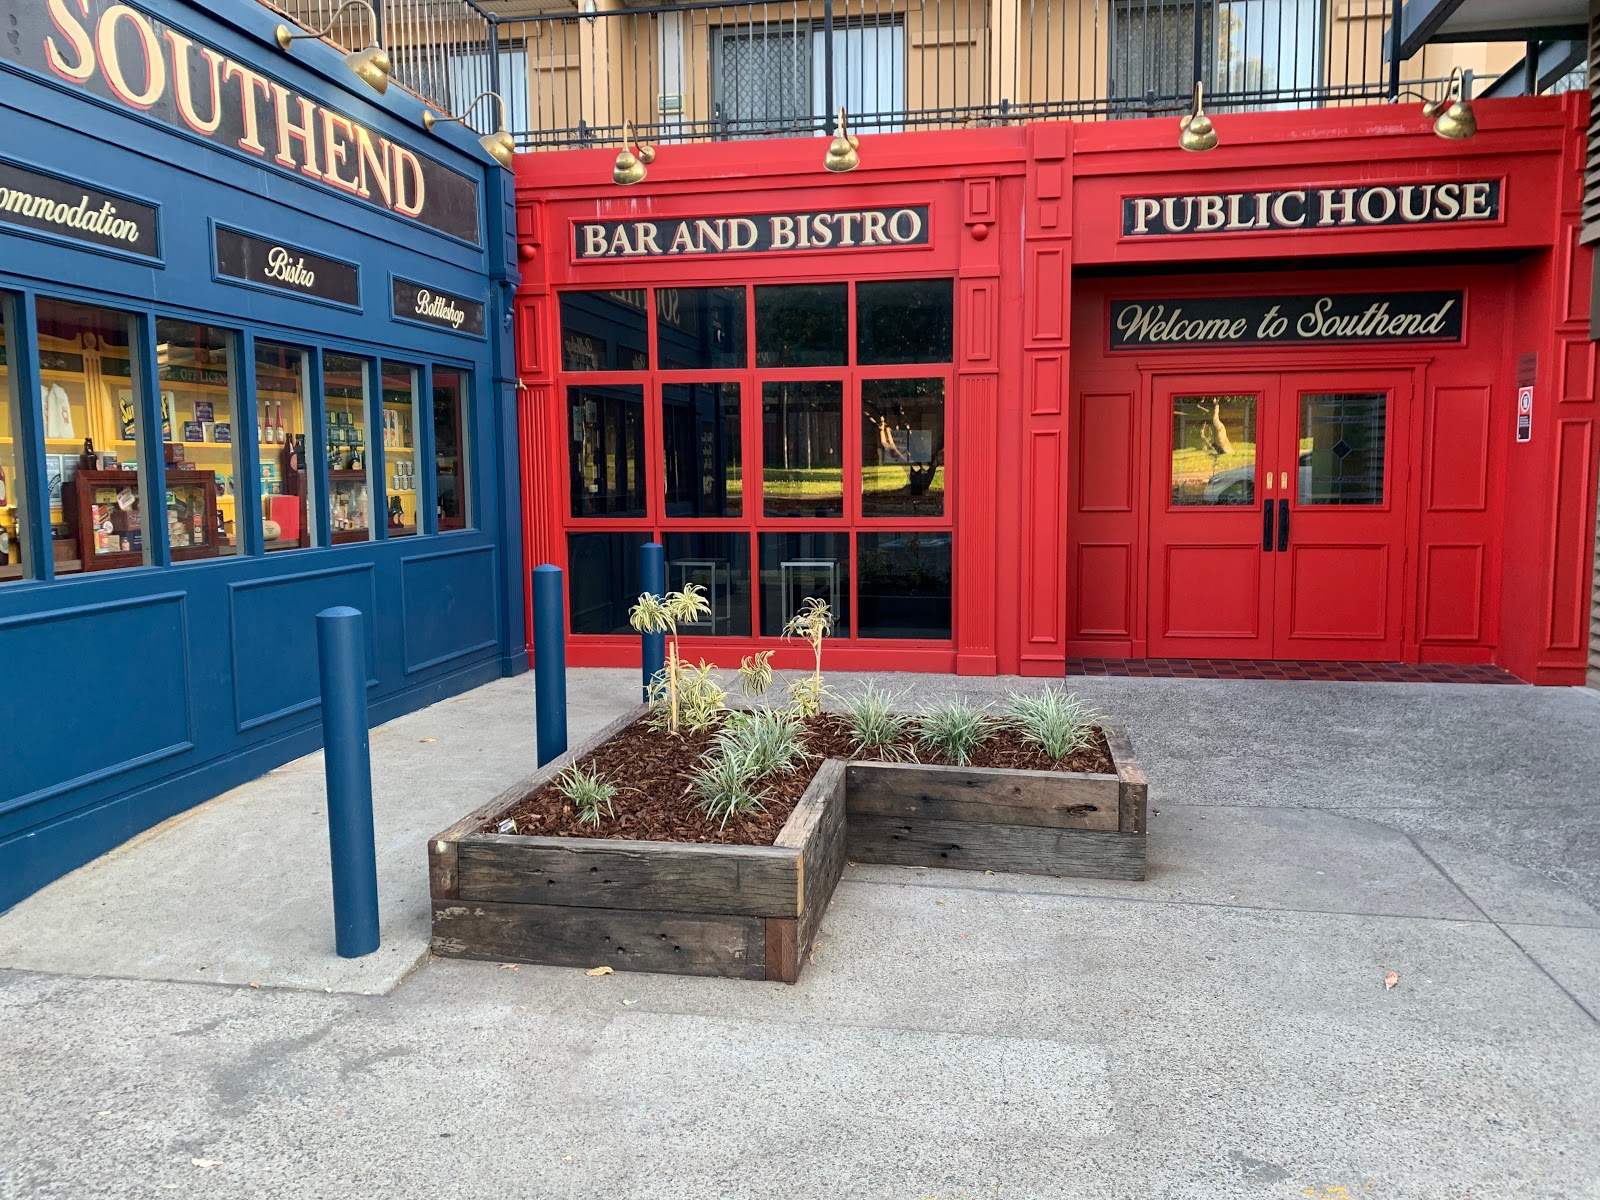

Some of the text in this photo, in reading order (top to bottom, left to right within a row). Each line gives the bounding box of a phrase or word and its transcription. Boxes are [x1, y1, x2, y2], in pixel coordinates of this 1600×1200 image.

[44, 0, 425, 218] SOUTHEND
[1131, 183, 1491, 235] PUBLIC HOUSE
[582, 209, 921, 257] BAR AND BISTRO
[264, 247, 315, 287] Bistro
[415, 289, 464, 328] Bottleshop
[1116, 297, 1455, 342] Welcome to Southend
